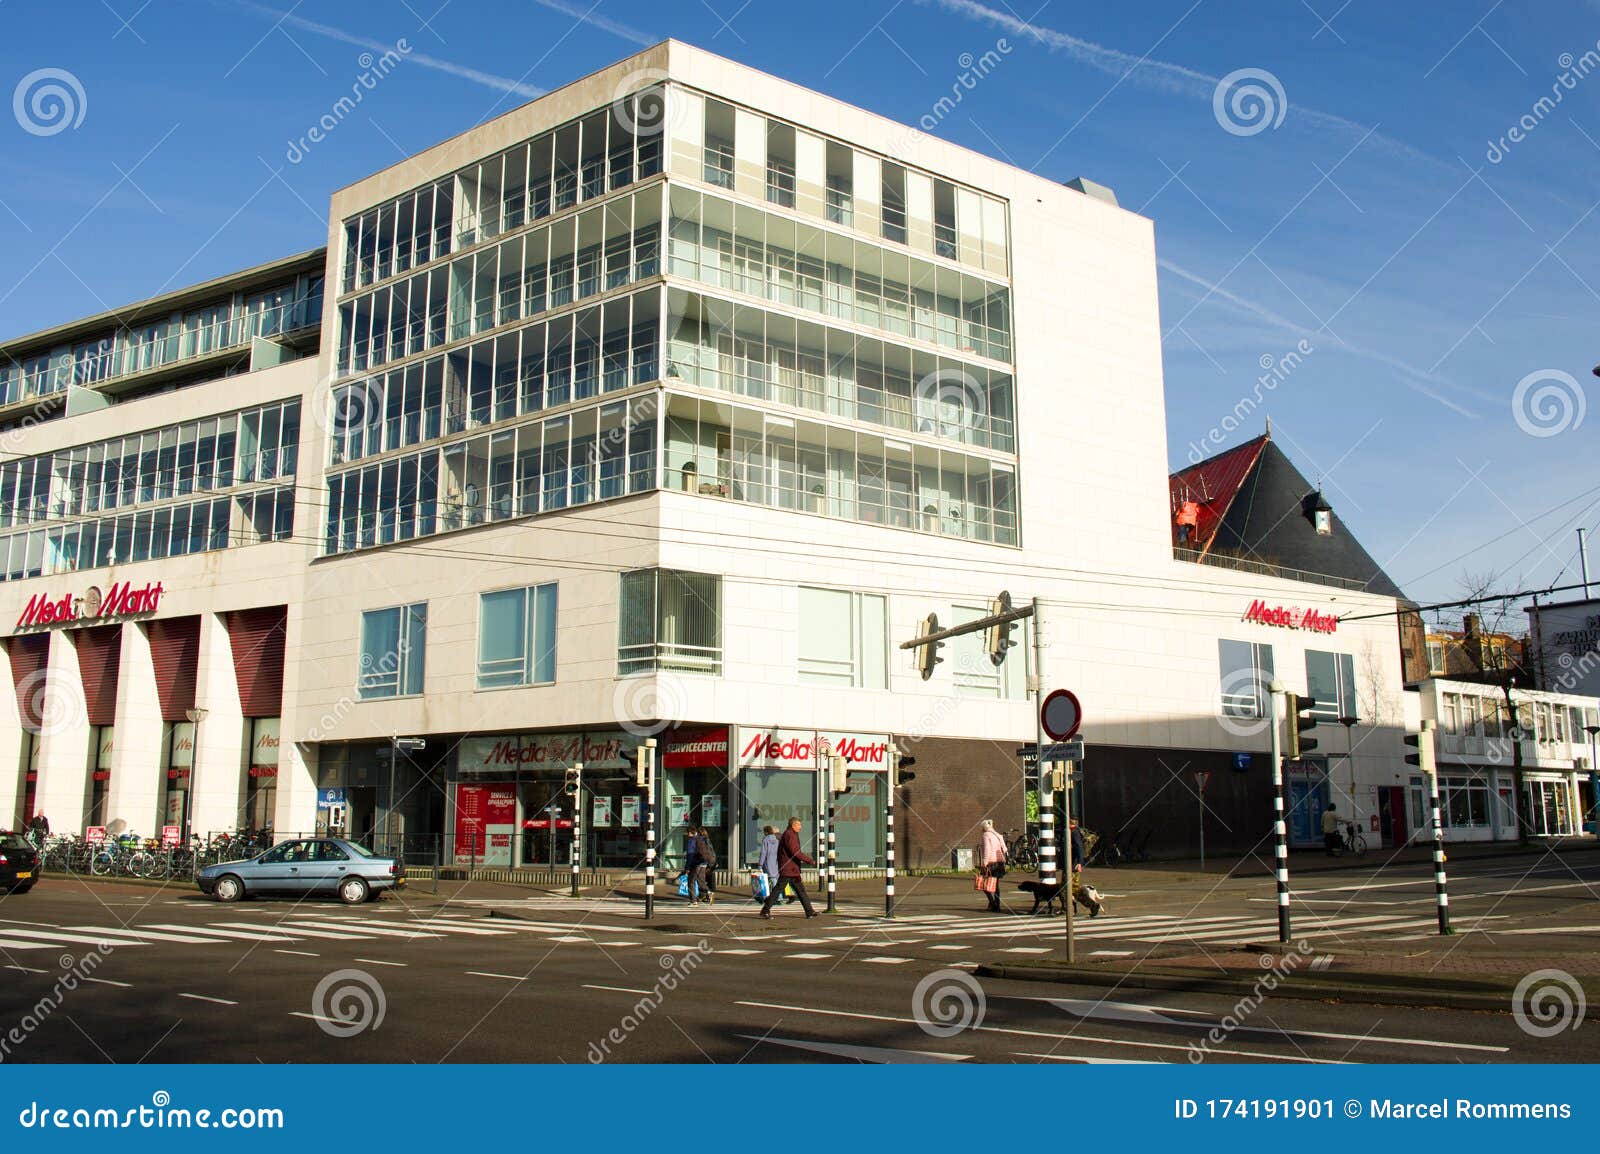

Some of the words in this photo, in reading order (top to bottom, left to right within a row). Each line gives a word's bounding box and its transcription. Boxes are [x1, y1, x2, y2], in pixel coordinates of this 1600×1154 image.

[97, 581, 164, 617] Markt
[1245, 599, 1291, 625] Media
[1301, 607, 1337, 632] Markt
[483, 741, 546, 764] Media
[560, 737, 621, 762] Markt
[666, 741, 727, 753] SERVICECENTER
[741, 734, 810, 760] Media
[835, 738, 887, 763] Markt
